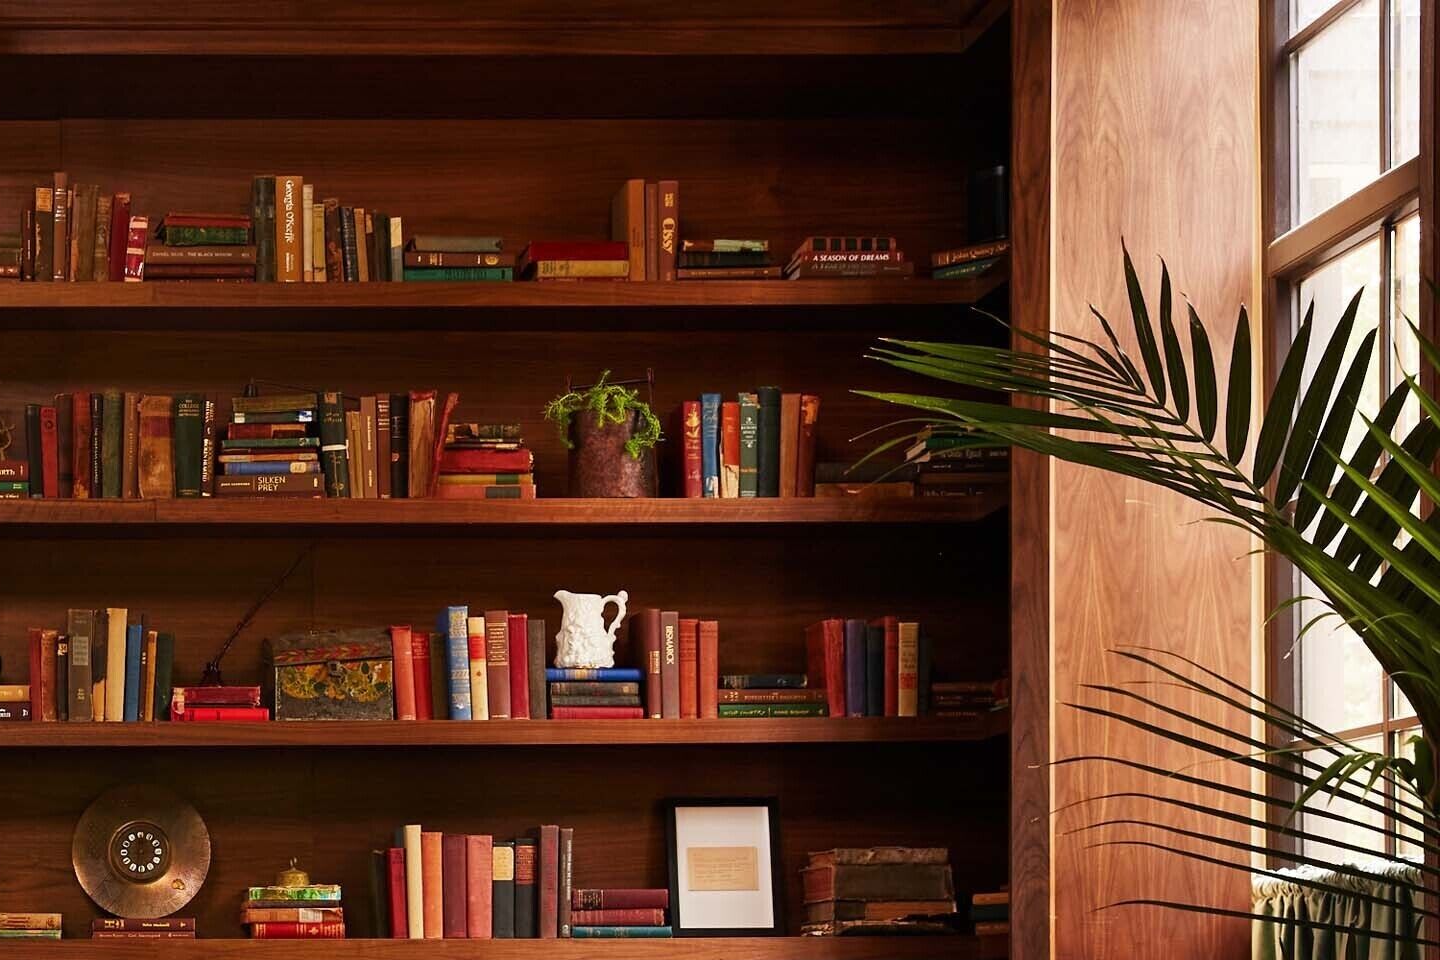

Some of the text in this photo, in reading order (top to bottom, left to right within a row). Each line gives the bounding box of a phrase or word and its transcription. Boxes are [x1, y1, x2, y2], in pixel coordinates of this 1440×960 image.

[283, 180, 294, 211] Georgia
[284, 212, 295, 243] O'Keeffe
[665, 625, 675, 665] BISMARCK
